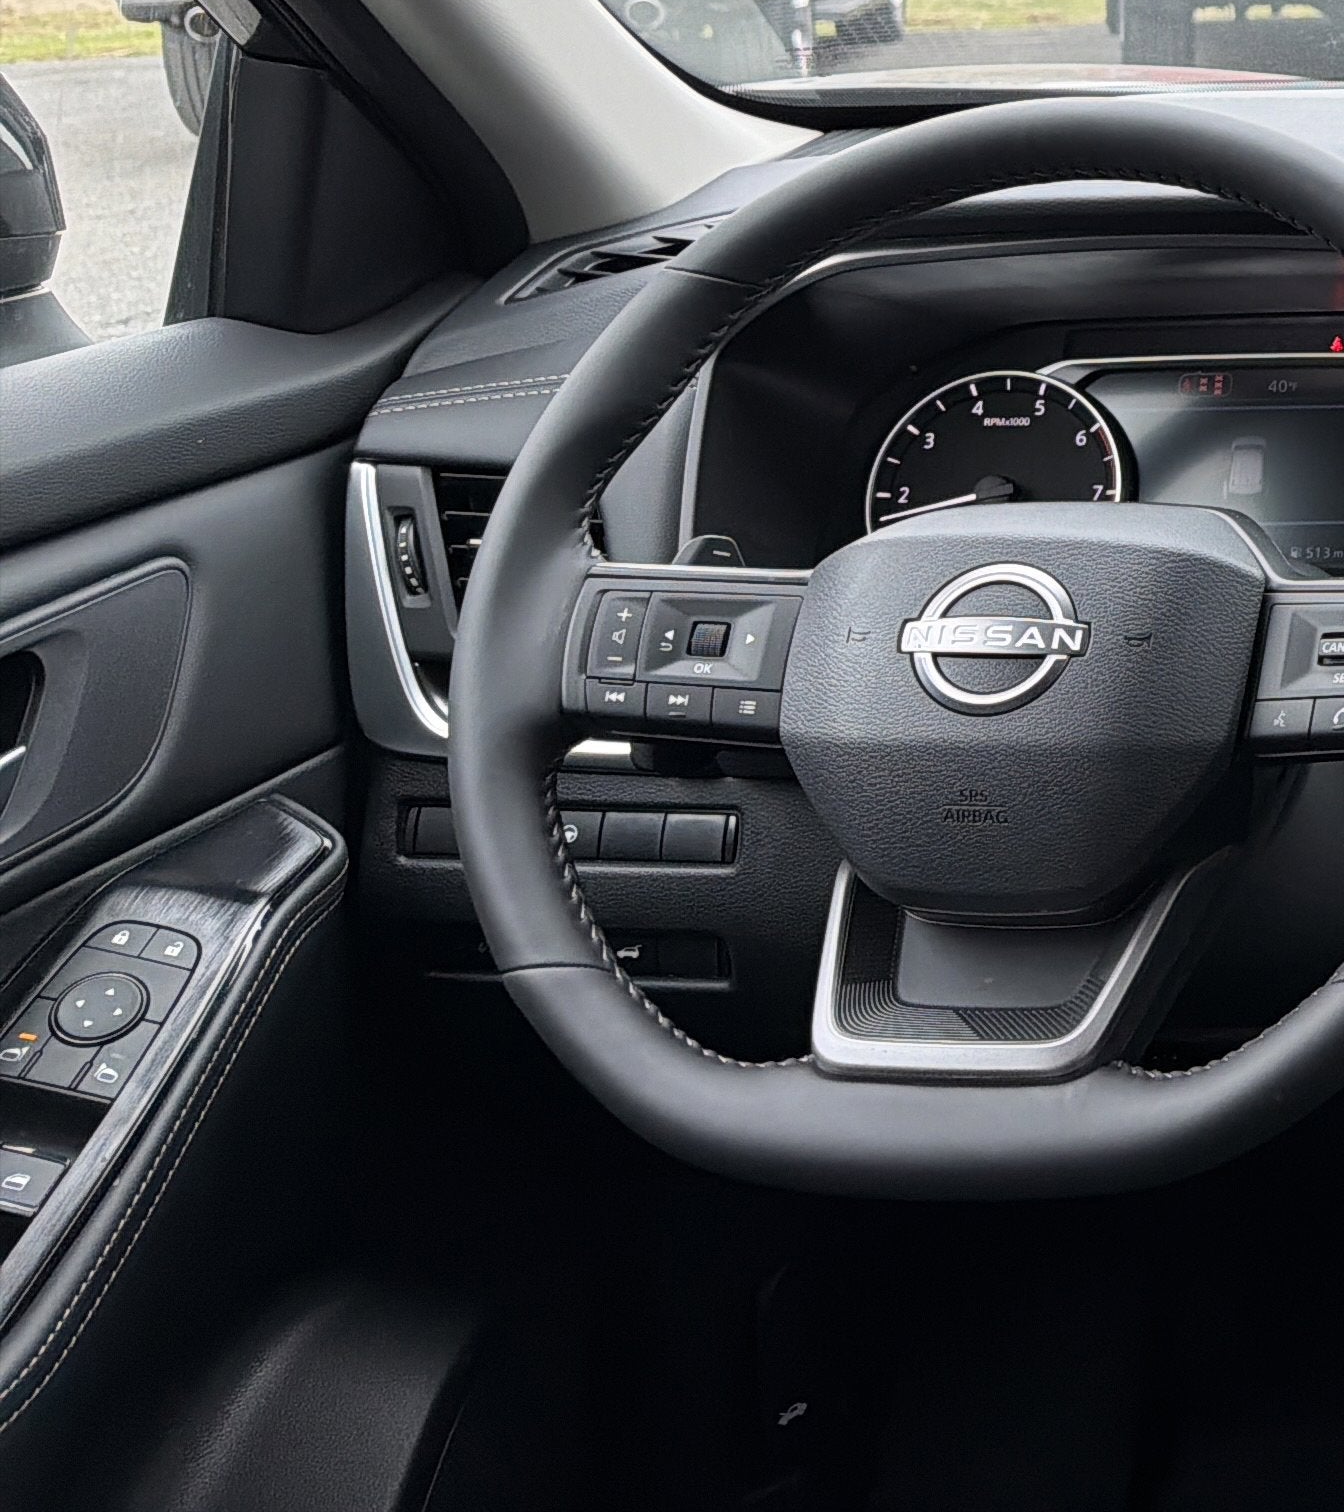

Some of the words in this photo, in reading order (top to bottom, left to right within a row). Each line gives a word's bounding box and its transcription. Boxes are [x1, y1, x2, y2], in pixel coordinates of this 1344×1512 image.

[971, 400, 984, 416] 4
[1034, 399, 1045, 416] 5
[923, 432, 935, 449] 3
[1075, 430, 1087, 446] 6
[897, 487, 910, 503] 2
[1092, 485, 1104, 501] 7
[1306, 546, 1331, 559] 513
[905, 623, 1083, 652] NISSAN
[693, 662, 713, 674] OK
[959, 789, 989, 803] SRS
[942, 808, 1010, 825] AIRBAG
